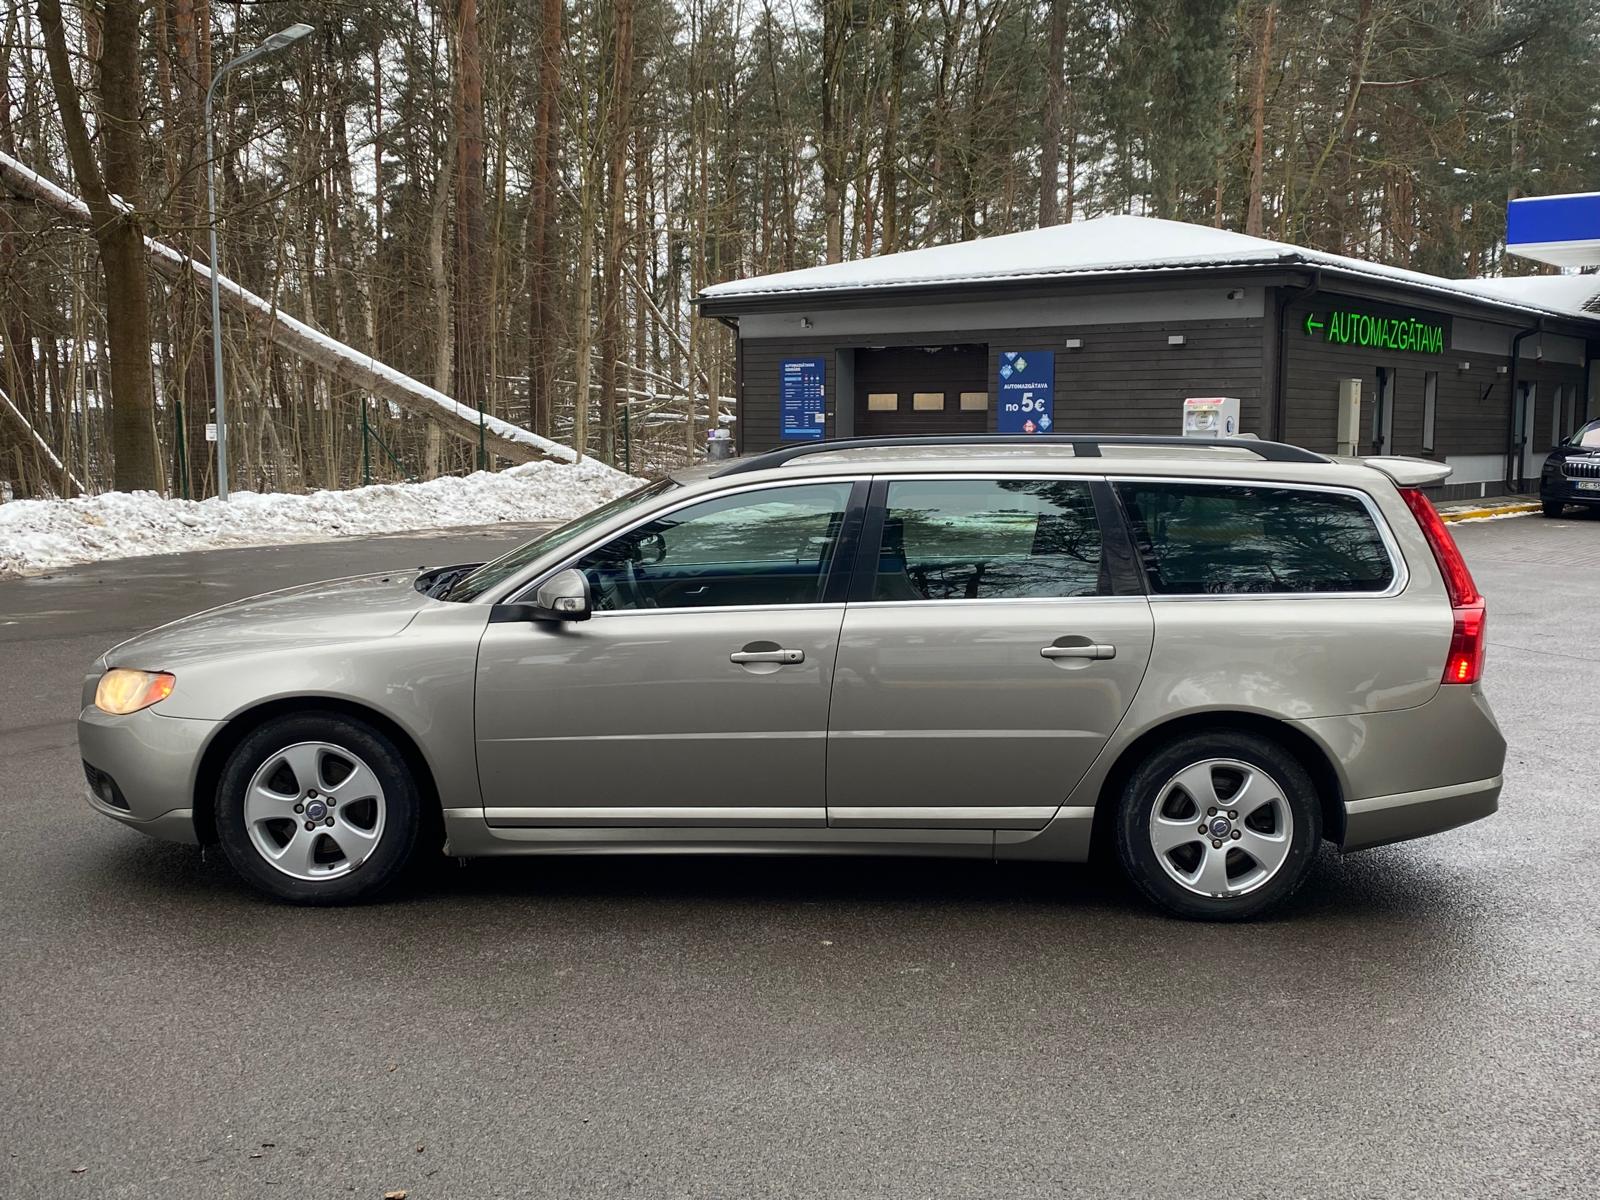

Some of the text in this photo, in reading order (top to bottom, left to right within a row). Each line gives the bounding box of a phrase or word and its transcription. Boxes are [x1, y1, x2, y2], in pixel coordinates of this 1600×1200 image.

[1329, 311, 1443, 354] AUTOMAZGĀTAVA
[1003, 382, 1048, 390] AUTOMAZGĀTAVA
[1005, 403, 1019, 412] no
